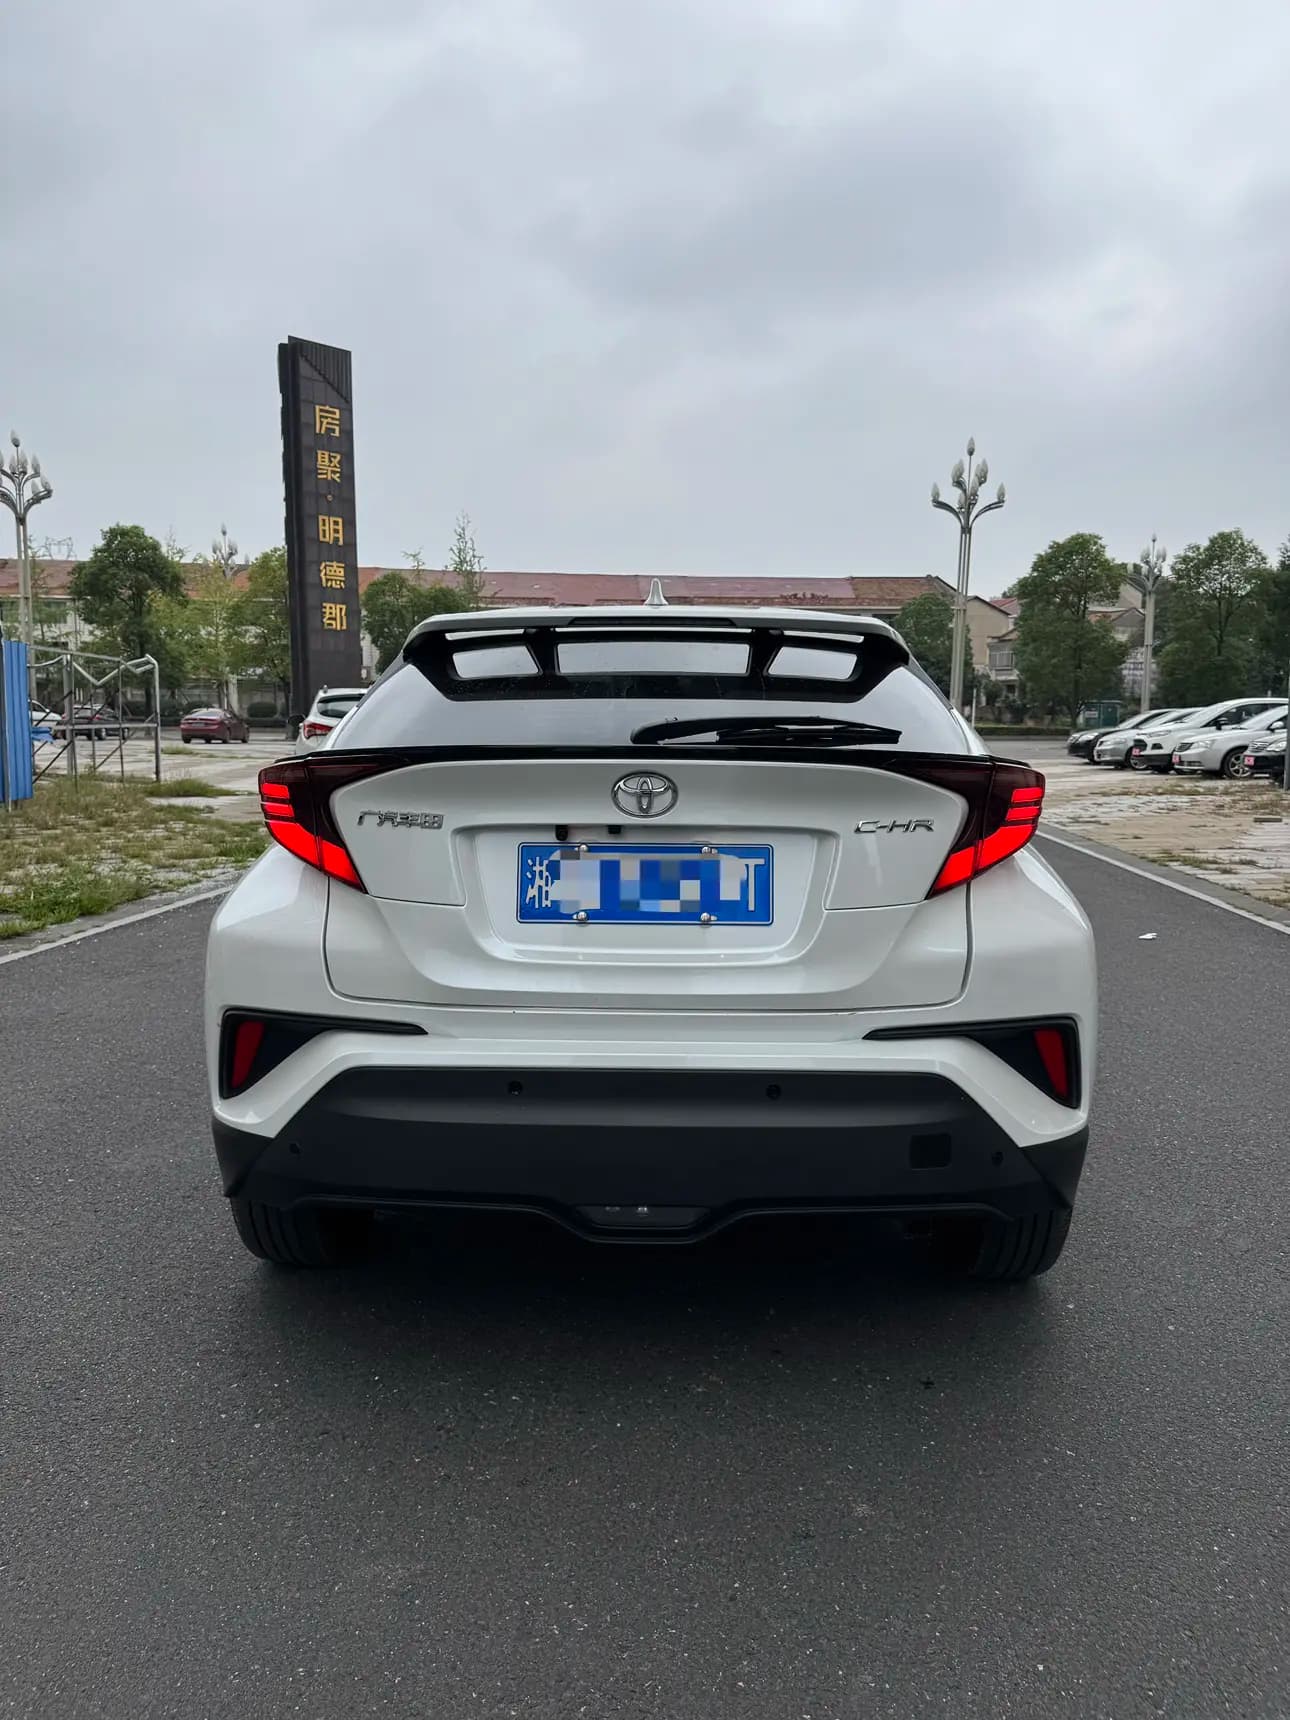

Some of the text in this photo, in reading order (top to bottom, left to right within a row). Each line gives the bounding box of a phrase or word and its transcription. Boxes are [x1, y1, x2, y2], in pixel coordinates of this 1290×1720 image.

[357, 809, 444, 829] 广汽丰田
[854, 819, 934, 834] C-HR
